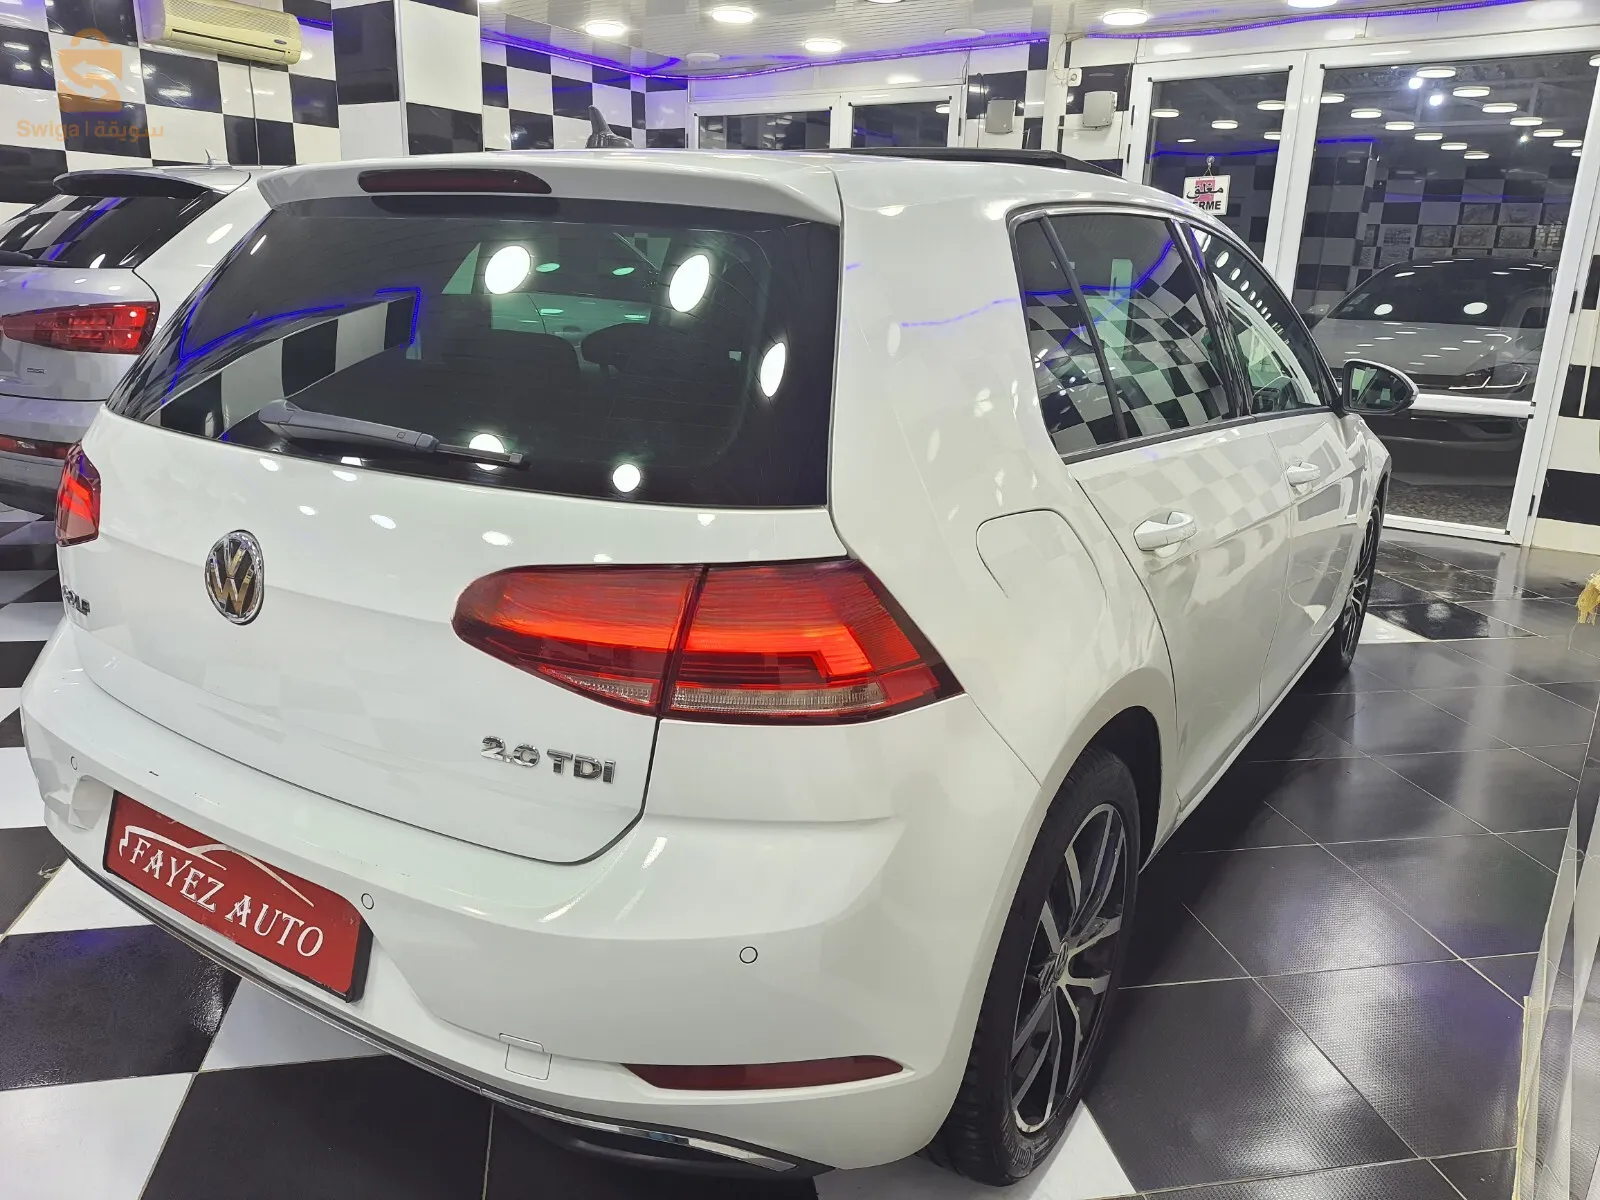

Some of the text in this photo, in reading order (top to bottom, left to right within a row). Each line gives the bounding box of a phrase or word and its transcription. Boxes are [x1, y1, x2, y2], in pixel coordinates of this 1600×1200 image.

[1186, 183, 1223, 199] مغلق
[1192, 201, 1222, 211] RME
[480, 735, 616, 784] 2.0 TDI
[129, 837, 324, 957] FAYEZ AUTO
